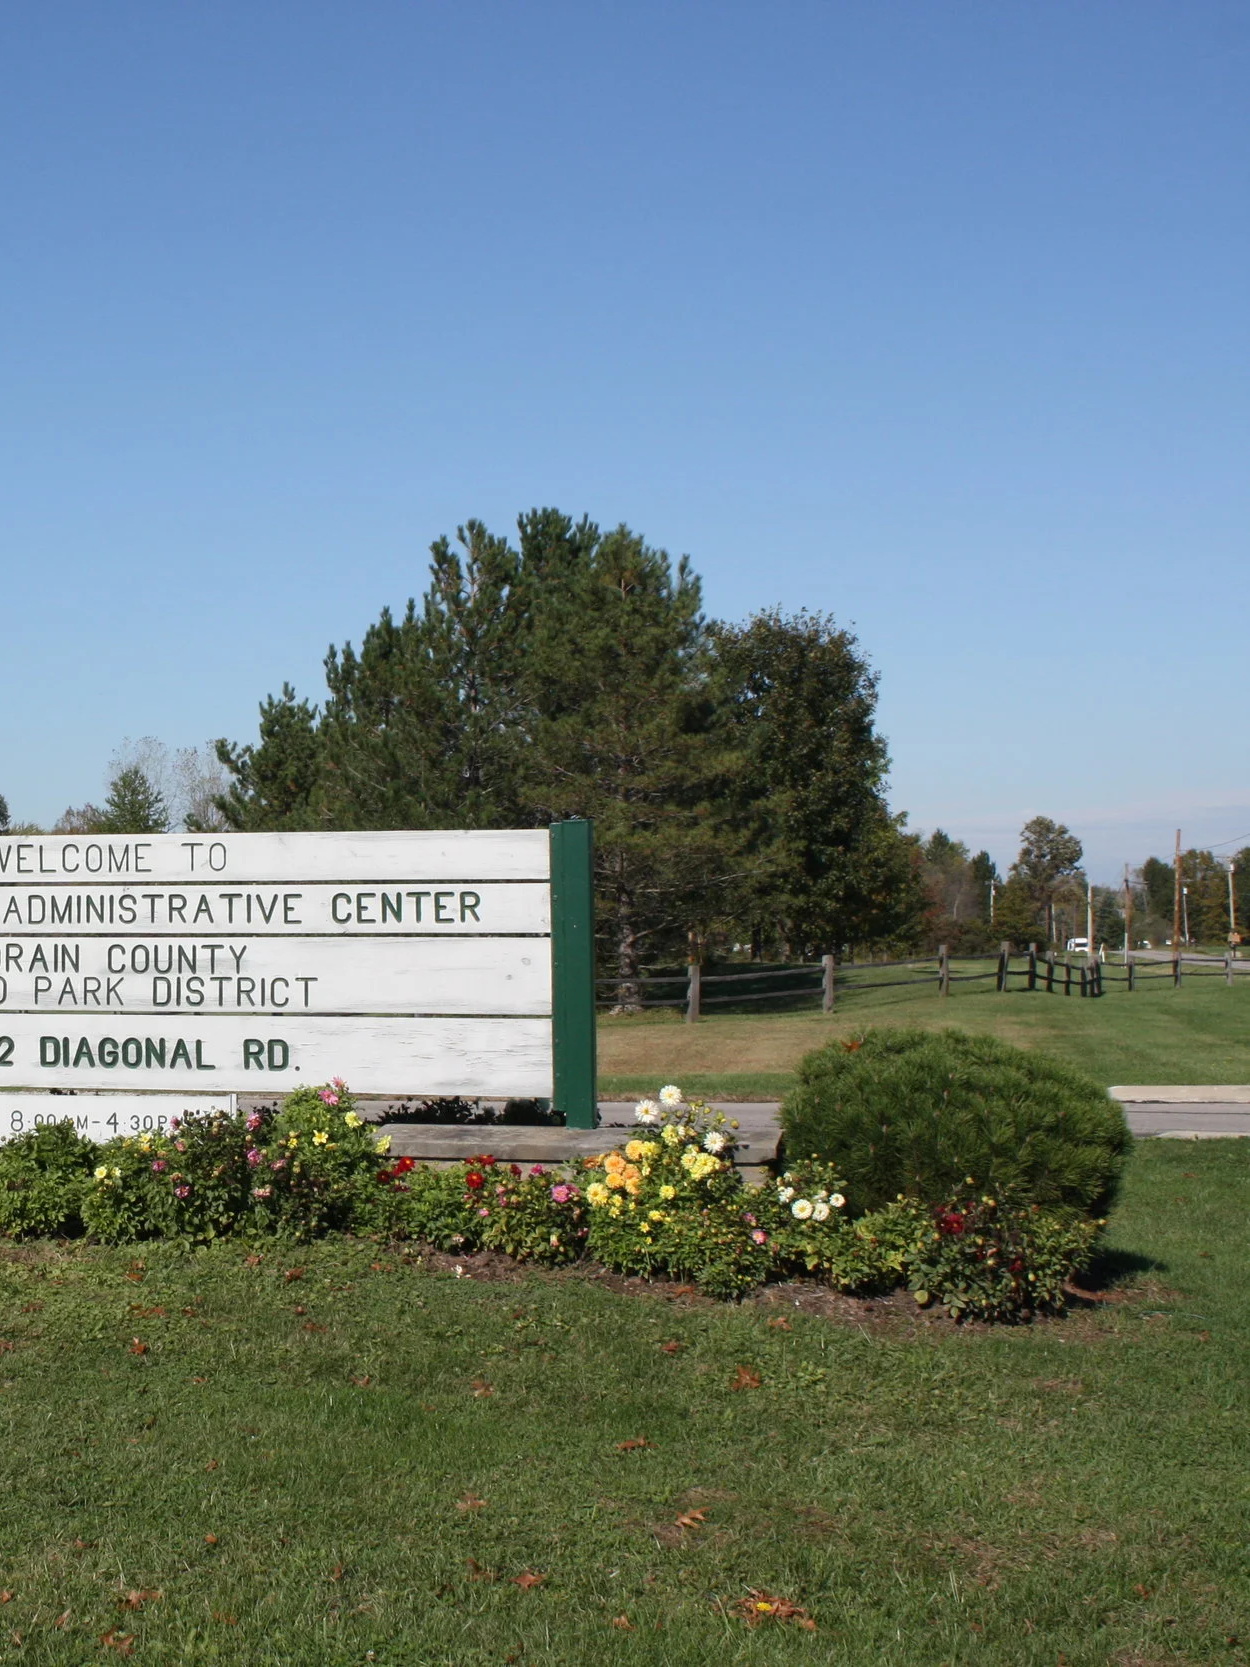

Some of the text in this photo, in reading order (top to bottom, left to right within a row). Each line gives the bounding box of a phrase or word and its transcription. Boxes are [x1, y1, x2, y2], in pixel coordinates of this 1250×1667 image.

[181, 842, 227, 872] TO
[2, 893, 303, 926] ADMINISTRATIVE
[330, 891, 482, 924] CENTER
[106, 944, 248, 975] COUNTY
[34, 976, 125, 1007] PARK
[152, 976, 318, 1008] DISTRICT
[39, 1036, 216, 1070] DIAGONAL
[243, 1038, 302, 1072] RD.
